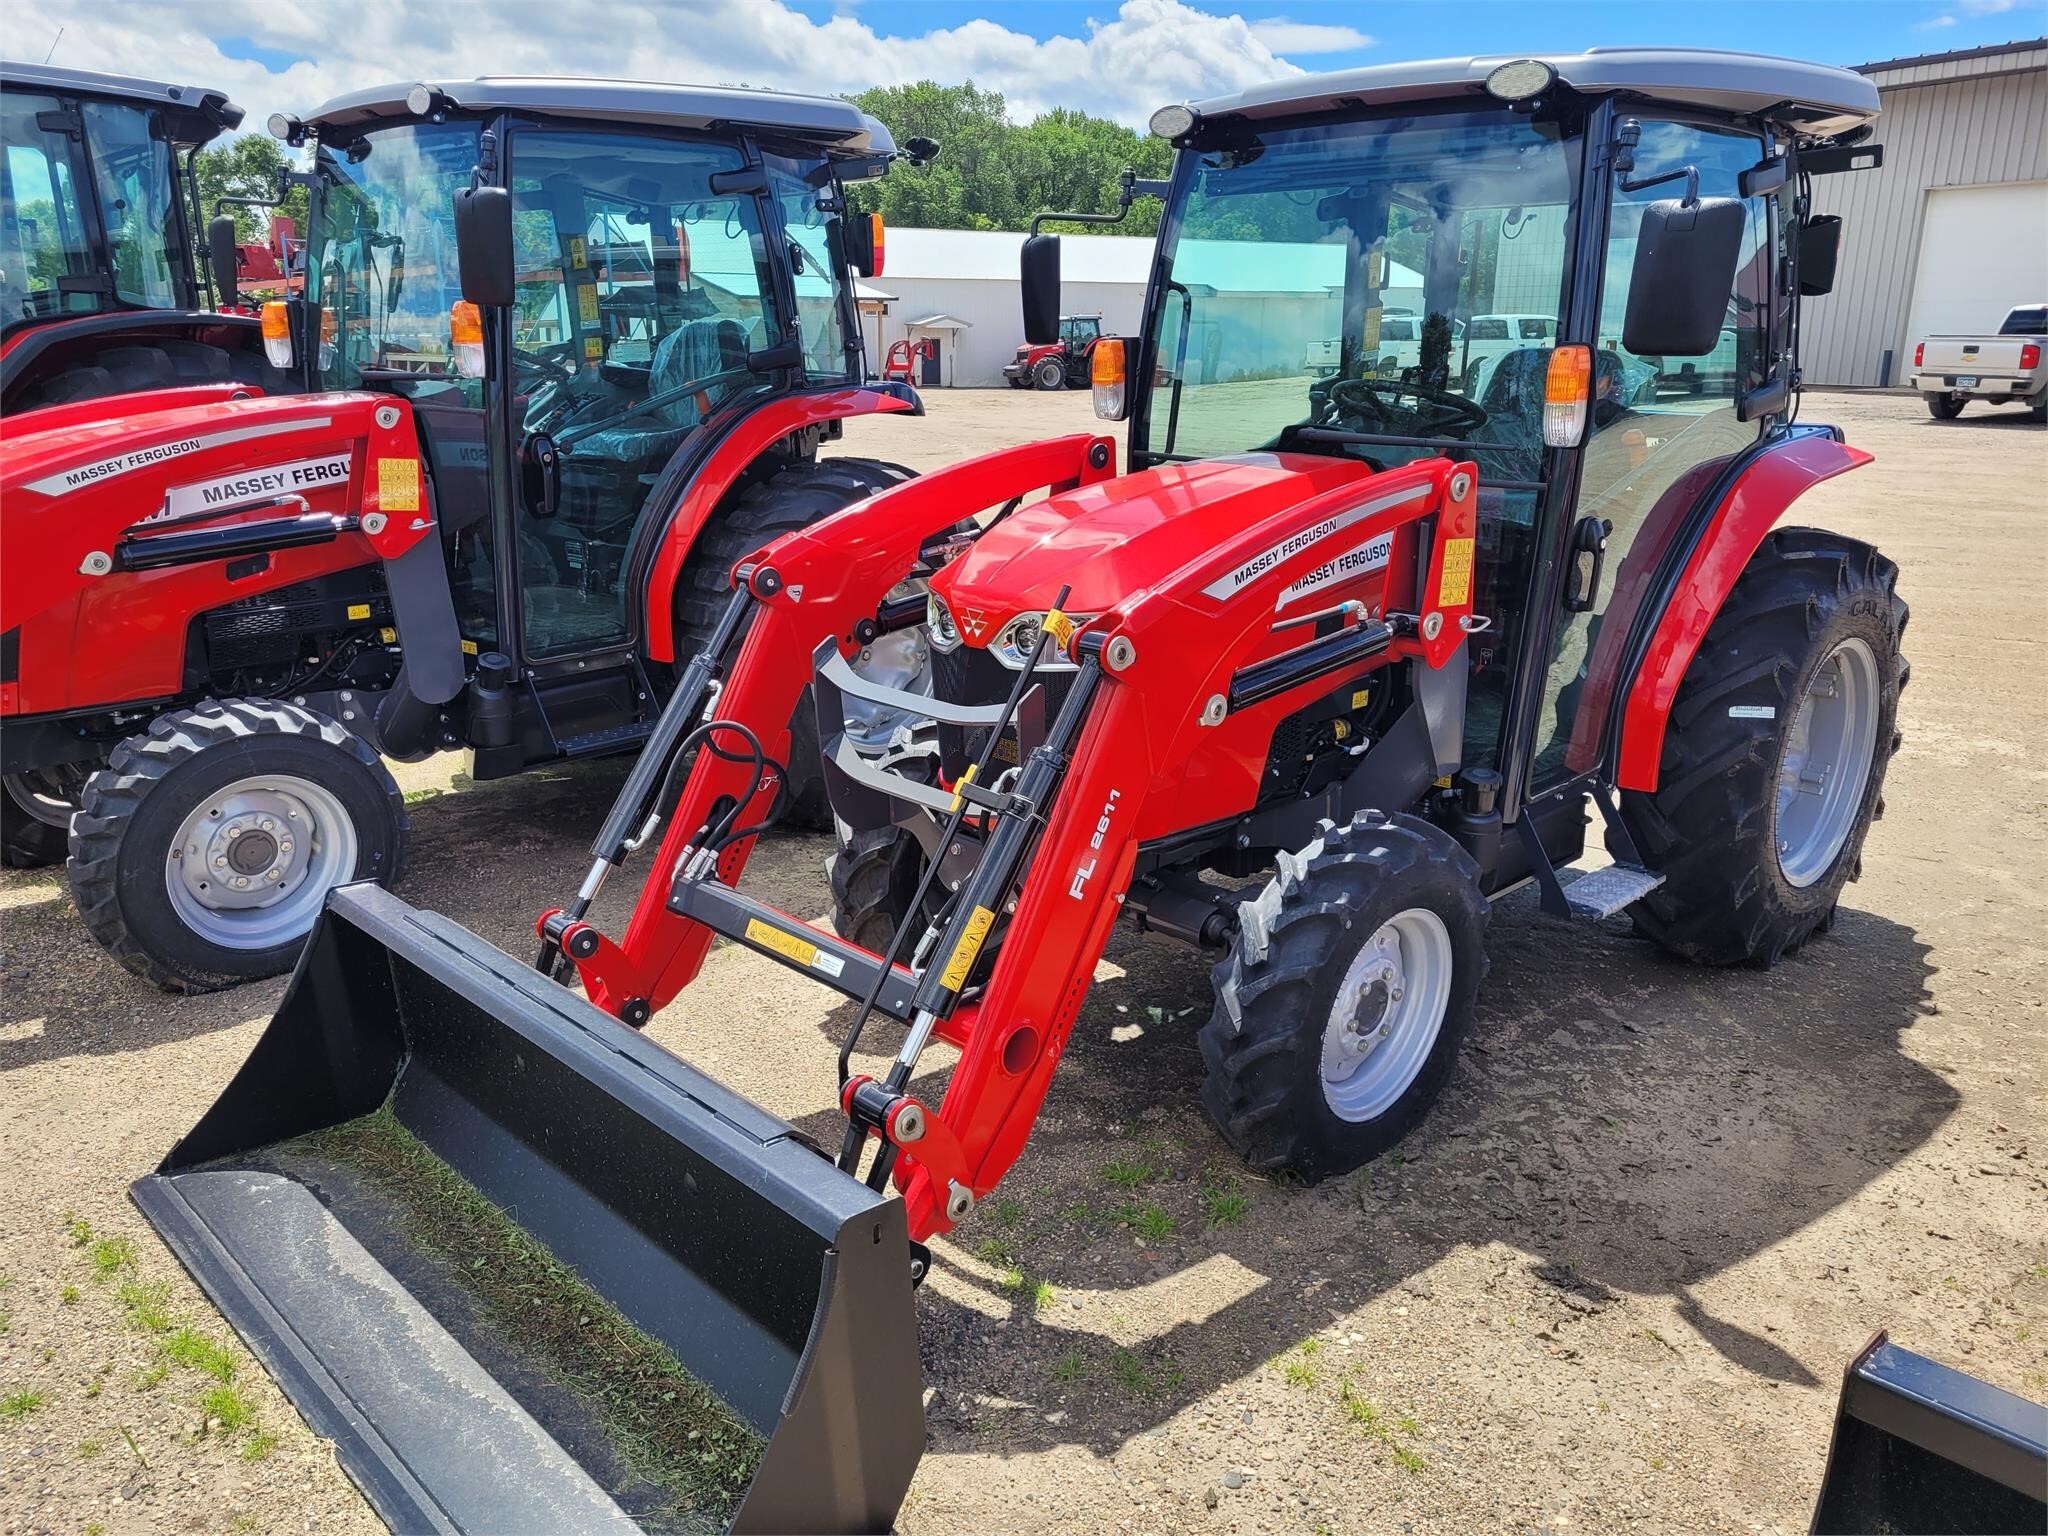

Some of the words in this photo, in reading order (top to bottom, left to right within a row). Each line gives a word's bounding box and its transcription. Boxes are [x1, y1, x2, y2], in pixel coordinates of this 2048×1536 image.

[65, 459, 124, 486] MASSEY
[127, 439, 201, 467] FERGUSON
[202, 472, 285, 504] MASSEY
[1234, 549, 1279, 586] MASSEY
[1282, 518, 1338, 557] FERGUSON
[1068, 857, 1097, 900] FL
[1090, 788, 1121, 850] 2611
